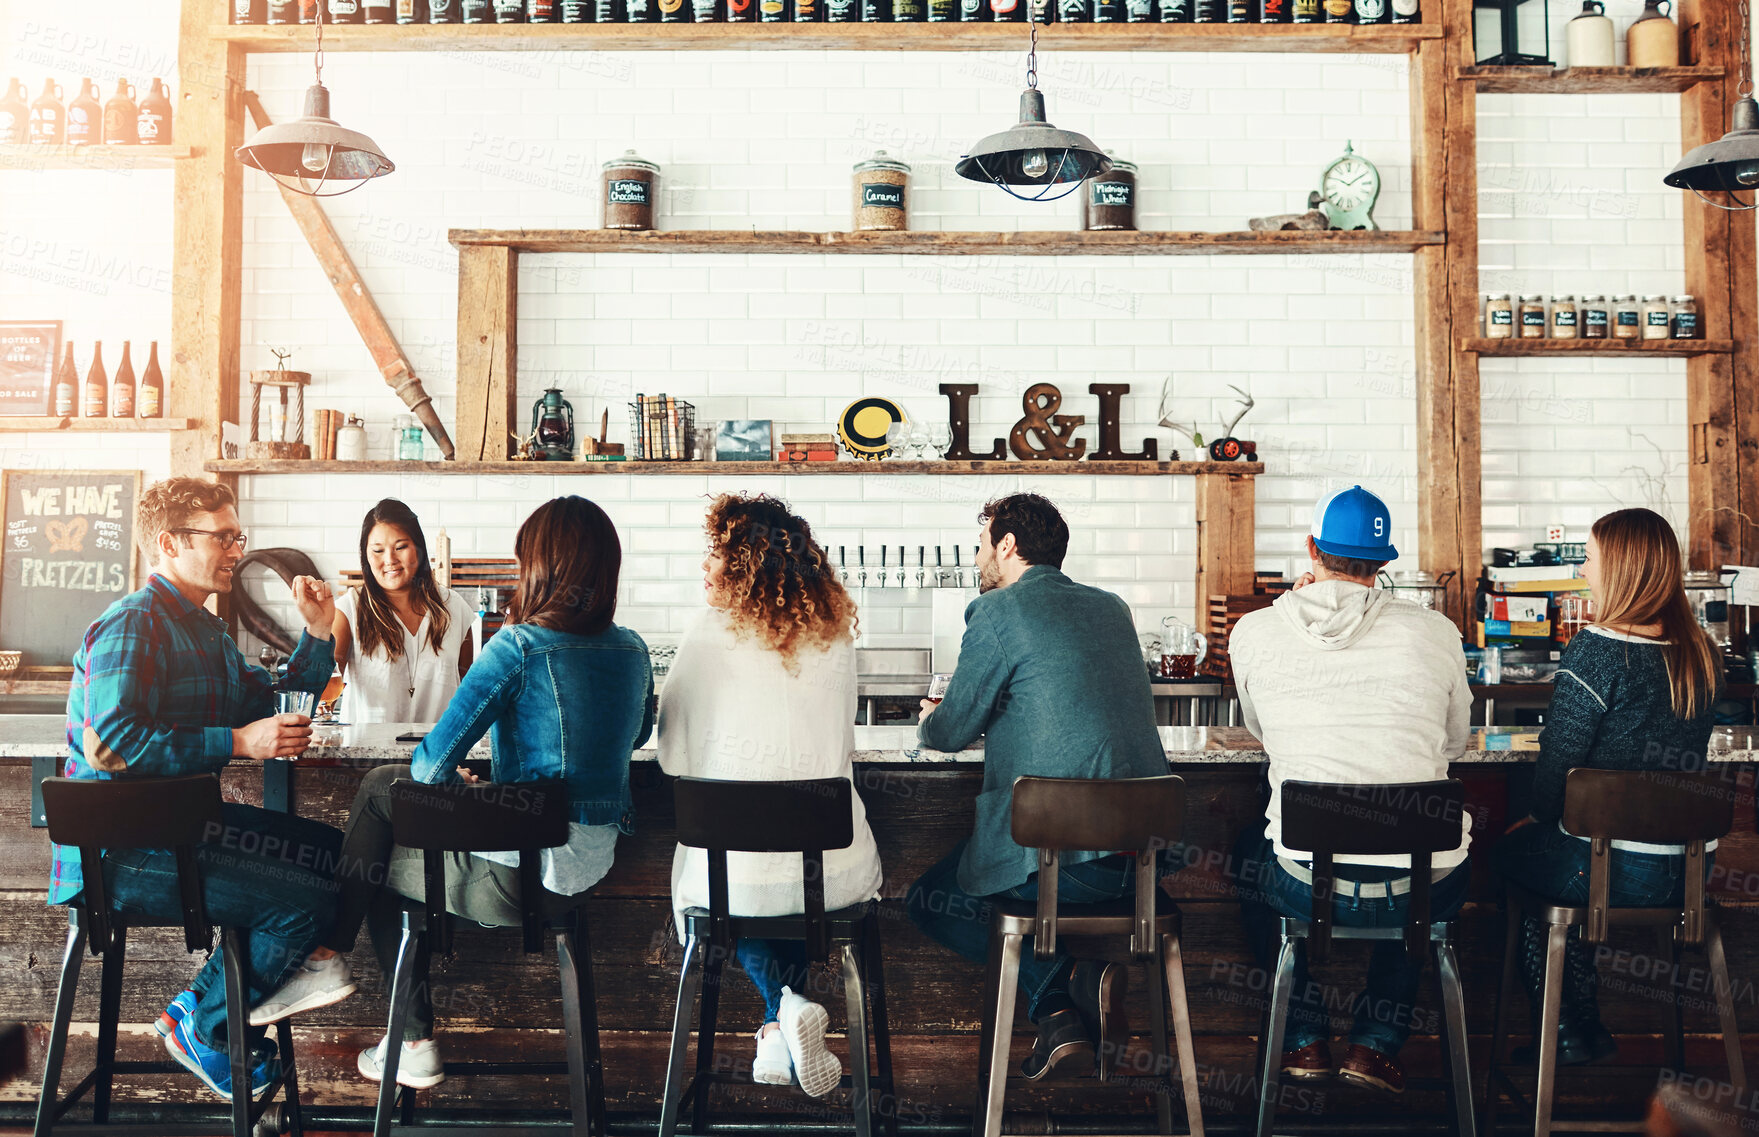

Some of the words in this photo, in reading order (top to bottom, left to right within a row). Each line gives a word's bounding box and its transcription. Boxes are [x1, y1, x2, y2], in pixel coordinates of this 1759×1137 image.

[614, 182, 644, 194] English
[1096, 184, 1130, 196] Midnight
[611, 191, 646, 202] Chocolate
[866, 188, 900, 202] Caramel
[1102, 194, 1128, 203] Wheat
[0, 390, 11, 398] OR
[14, 390, 38, 398] SALE
[21, 487, 60, 516] WE
[65, 484, 122, 518] HAVE
[1374, 516, 1384, 537] 9
[14, 536, 28, 548] $6
[21, 558, 125, 592] PRETZELS
